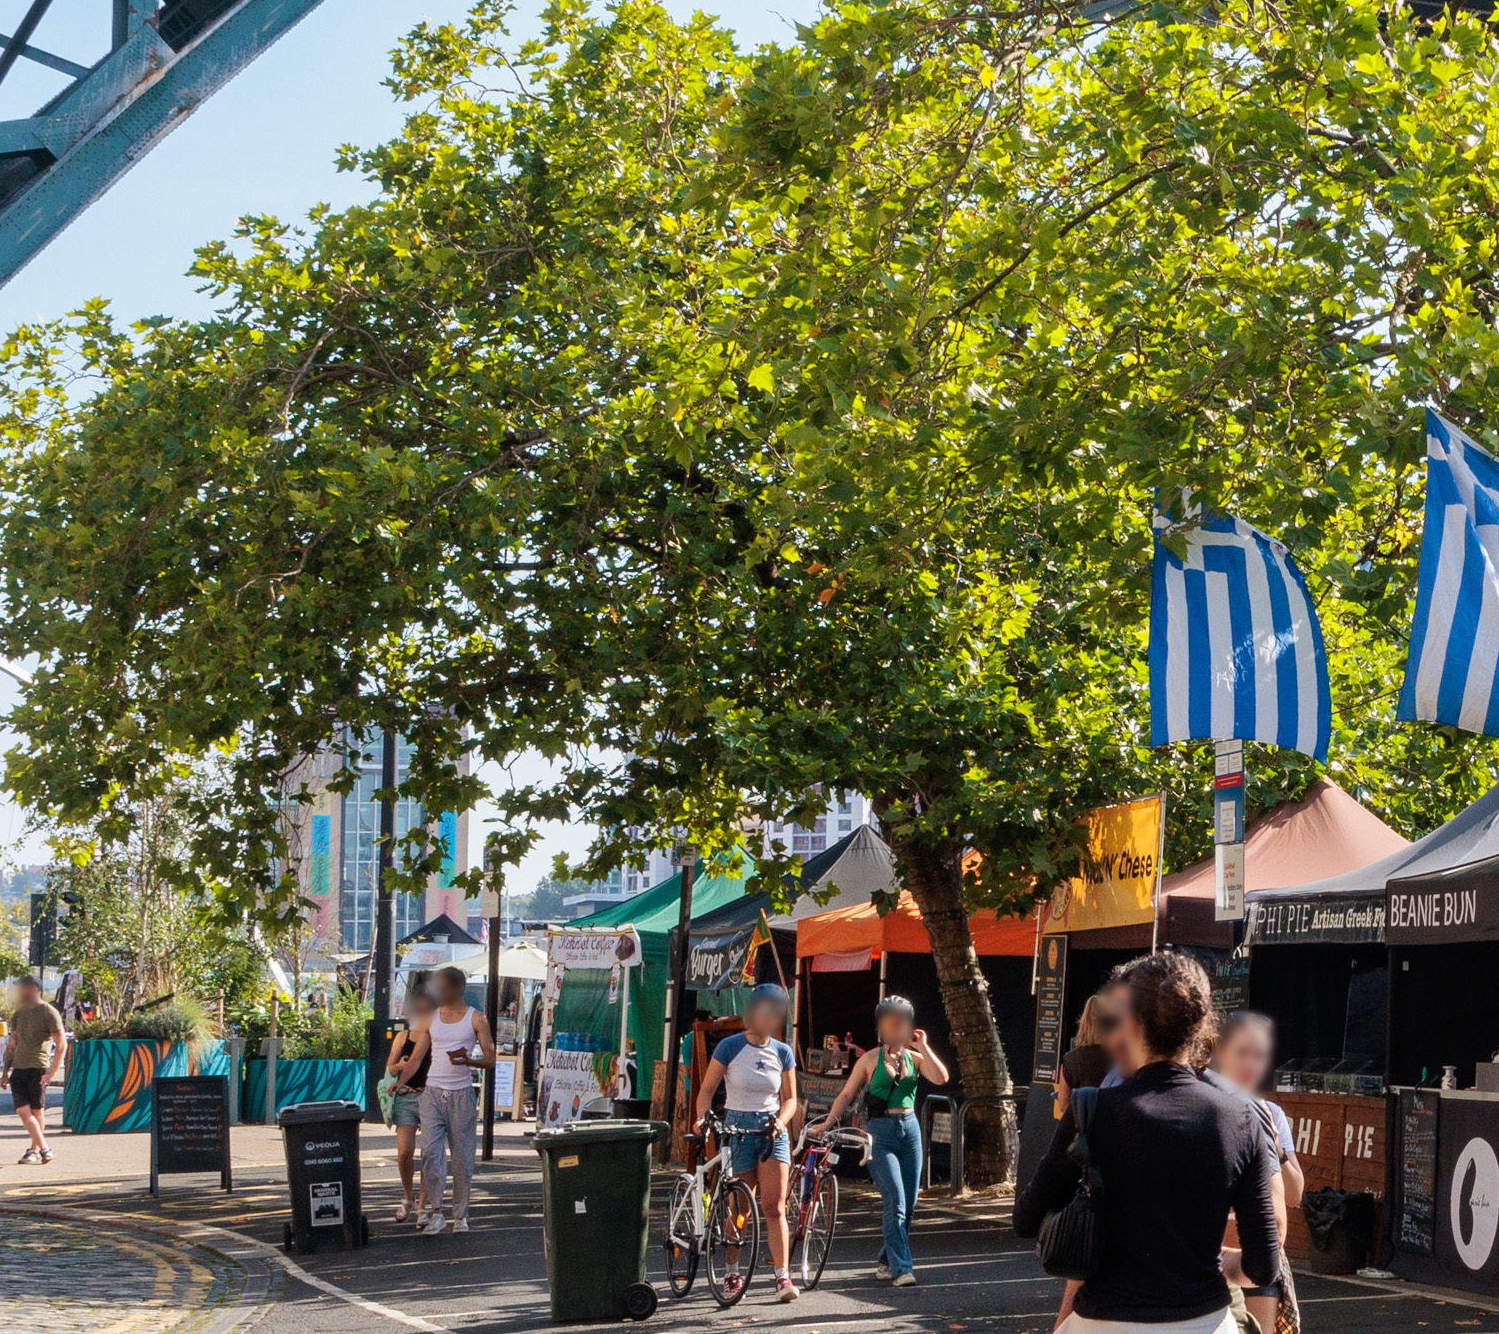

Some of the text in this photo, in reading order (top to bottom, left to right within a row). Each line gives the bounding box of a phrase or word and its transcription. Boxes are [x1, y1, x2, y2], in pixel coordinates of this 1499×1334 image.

[1118, 849, 1153, 880] Chese
[1256, 905, 1284, 934] PHI
[1287, 903, 1311, 933] PIE
[1311, 909, 1345, 929] Artisan
[1345, 906, 1373, 928] Greek
[1390, 889, 1477, 927] BEANIE BUN
[690, 944, 724, 985] Burger
[316, 1141, 340, 1149] VEOLIA
[1344, 1123, 1375, 1158] PIE
